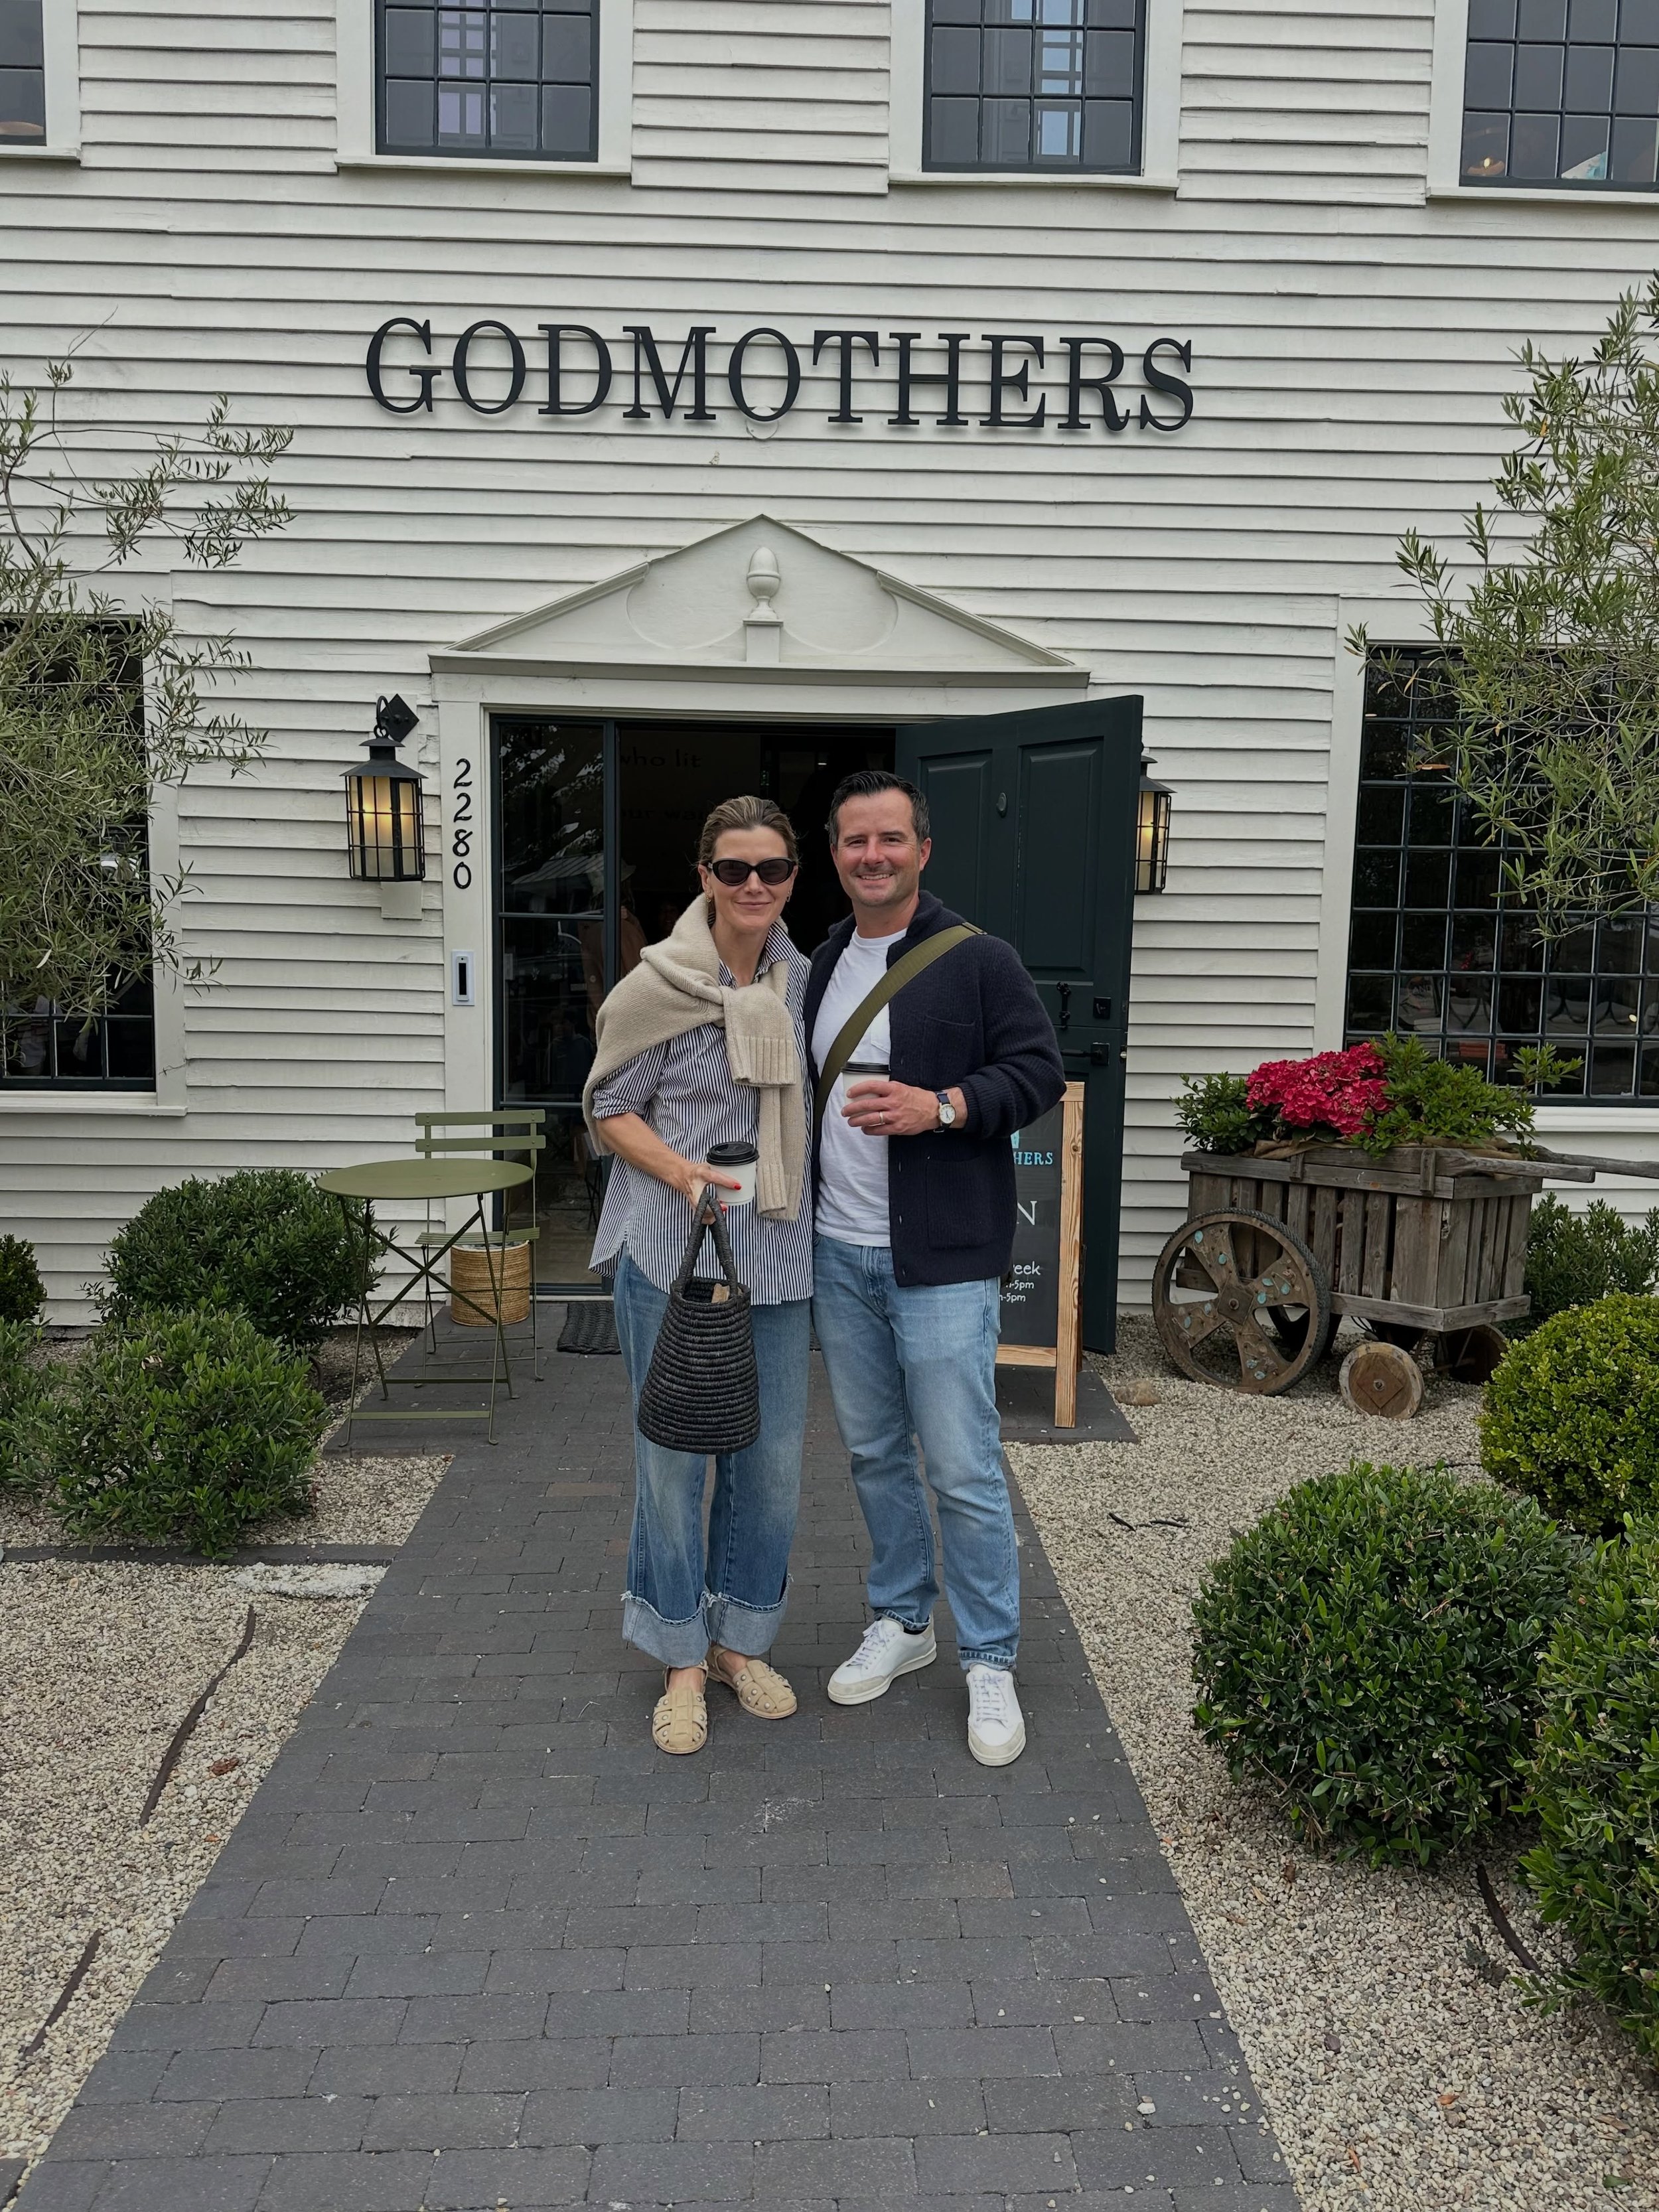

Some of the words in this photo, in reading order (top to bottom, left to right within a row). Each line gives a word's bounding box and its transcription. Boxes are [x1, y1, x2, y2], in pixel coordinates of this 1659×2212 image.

[366, 317, 1194, 431] GODMOTHERS
[620, 747, 666, 767] who
[676, 749, 703, 768] lit
[453, 759, 472, 889] 2280
[1013, 1261, 1041, 1276] eek
